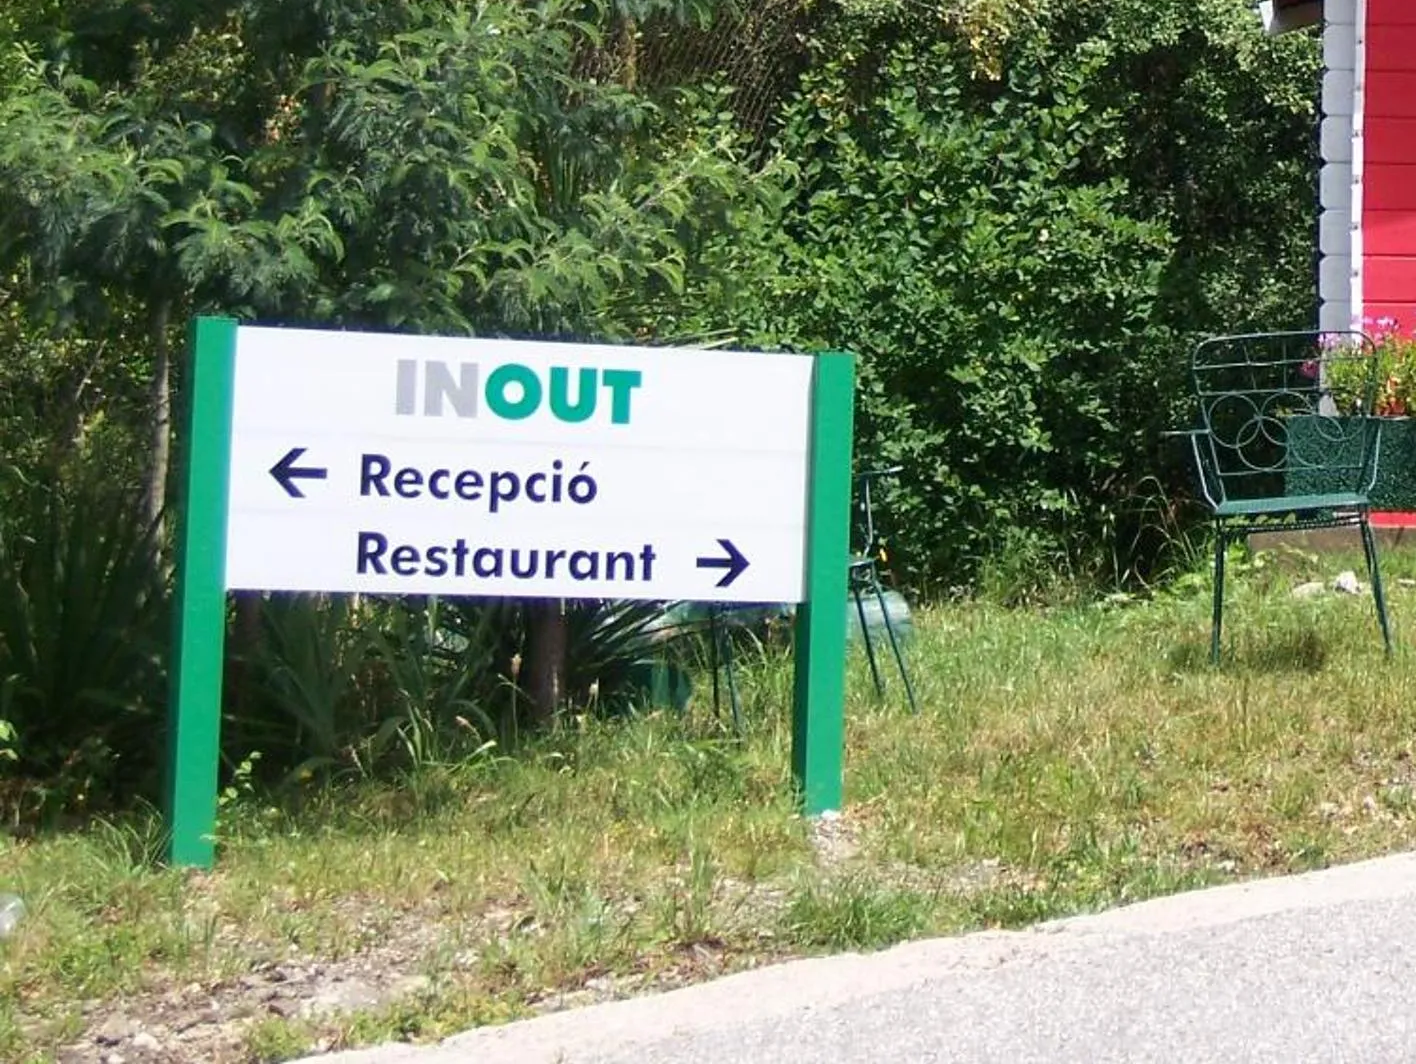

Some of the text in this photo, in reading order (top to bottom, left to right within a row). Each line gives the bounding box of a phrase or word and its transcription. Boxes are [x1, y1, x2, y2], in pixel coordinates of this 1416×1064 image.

[394, 358, 642, 425] INOUT
[359, 452, 599, 513] Recepció
[355, 531, 657, 582] Restaurant
